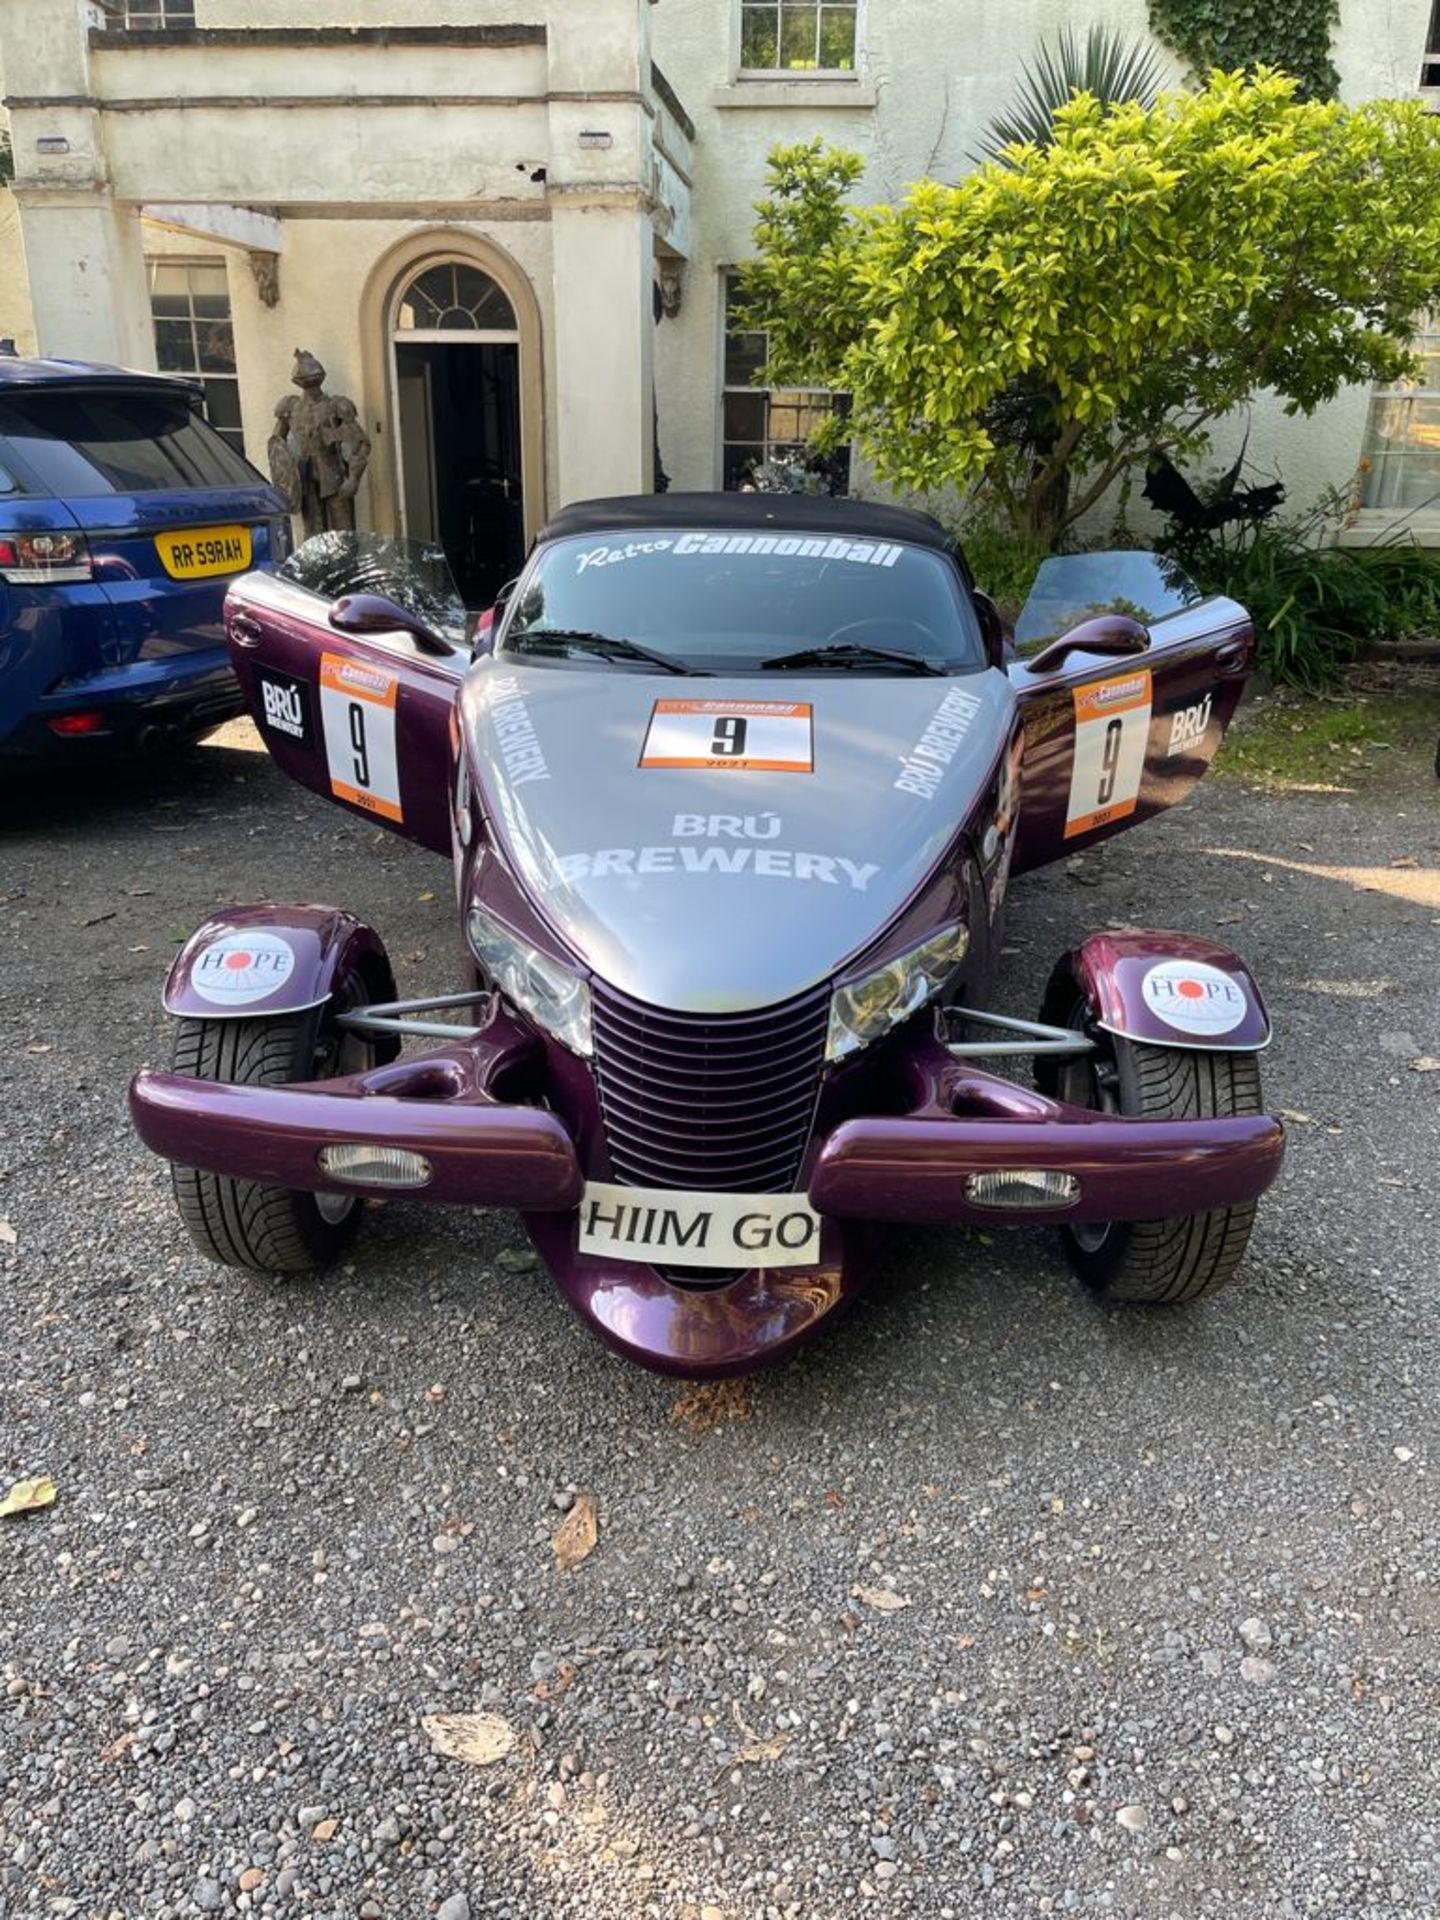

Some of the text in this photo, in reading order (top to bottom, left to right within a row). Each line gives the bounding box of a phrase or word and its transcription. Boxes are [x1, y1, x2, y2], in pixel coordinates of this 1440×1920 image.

[577, 533, 903, 574] Retro Cannonball
[262, 679, 303, 725] BRÚ
[1169, 693, 1212, 744] BRÚ
[267, 714, 304, 739] BREWERY
[349, 702, 370, 787] 9
[491, 700, 552, 787] BREWERY
[711, 717, 747, 756] 9
[893, 686, 982, 800] BRÚ BREWERY
[1098, 718, 1122, 805] 9
[672, 812, 781, 840] BRÚ
[555, 847, 880, 891] BREWERY
[202, 952, 286, 972] HOPE
[1152, 980, 1239, 1003] HOPE
[585, 1201, 815, 1251] HIIM GO
